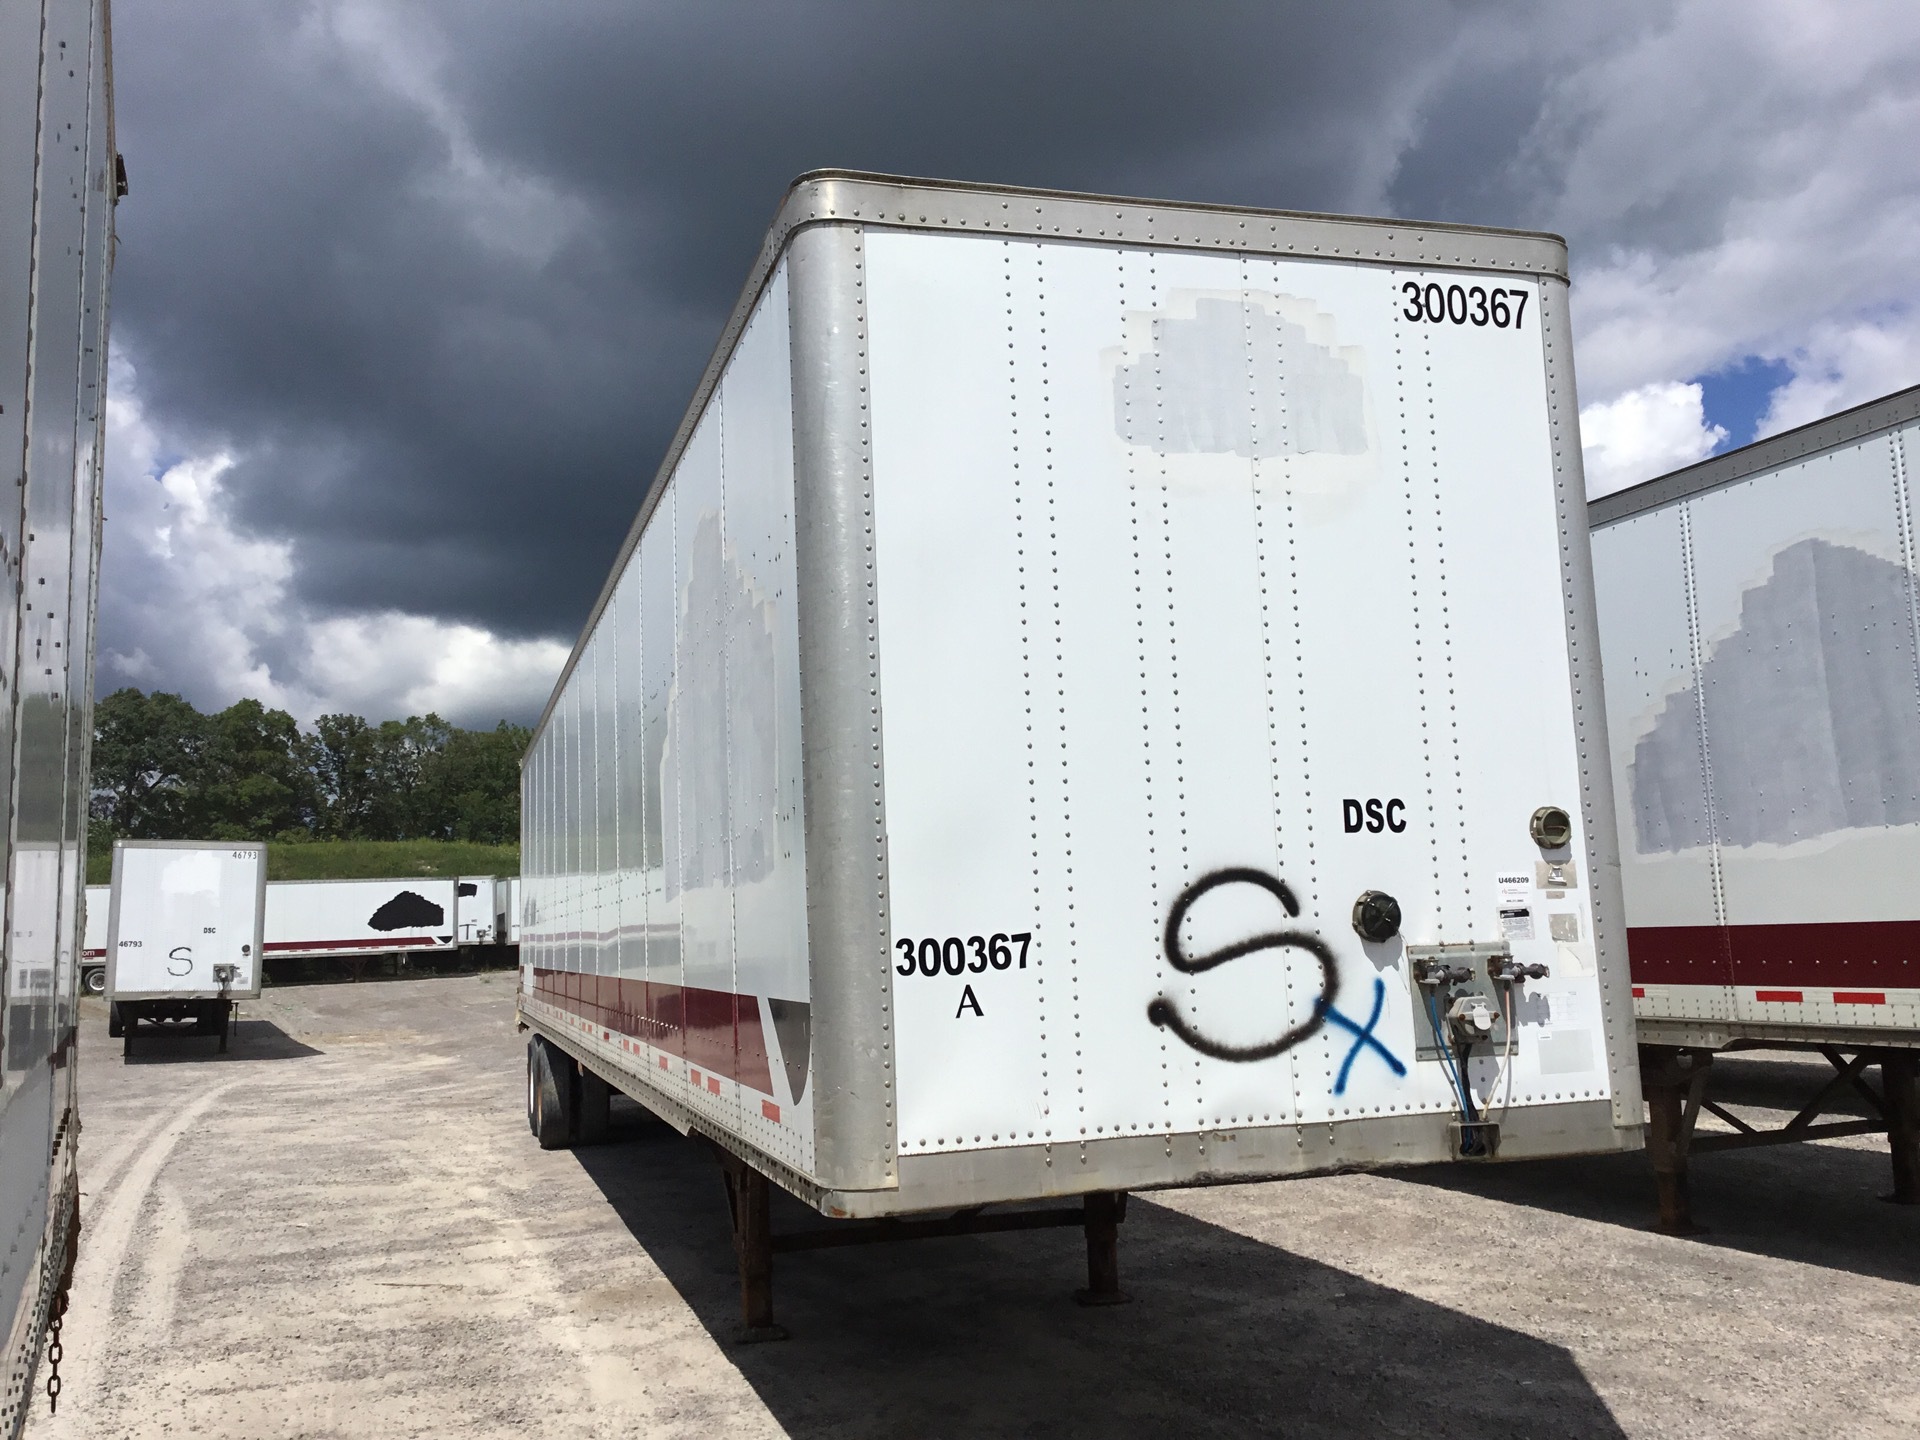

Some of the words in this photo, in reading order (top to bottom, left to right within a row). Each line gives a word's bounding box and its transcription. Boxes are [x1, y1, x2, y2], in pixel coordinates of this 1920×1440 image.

[1402, 281, 1529, 330] 300367
[1342, 798, 1407, 834] DSC
[232, 851, 257, 860] 46793
[1498, 876, 1530, 884] U466209
[118, 940, 143, 948] 46793
[167, 946, 193, 977] S
[895, 932, 1032, 977] 300367
[1147, 866, 1340, 1064] S
[955, 984, 985, 1019] A
